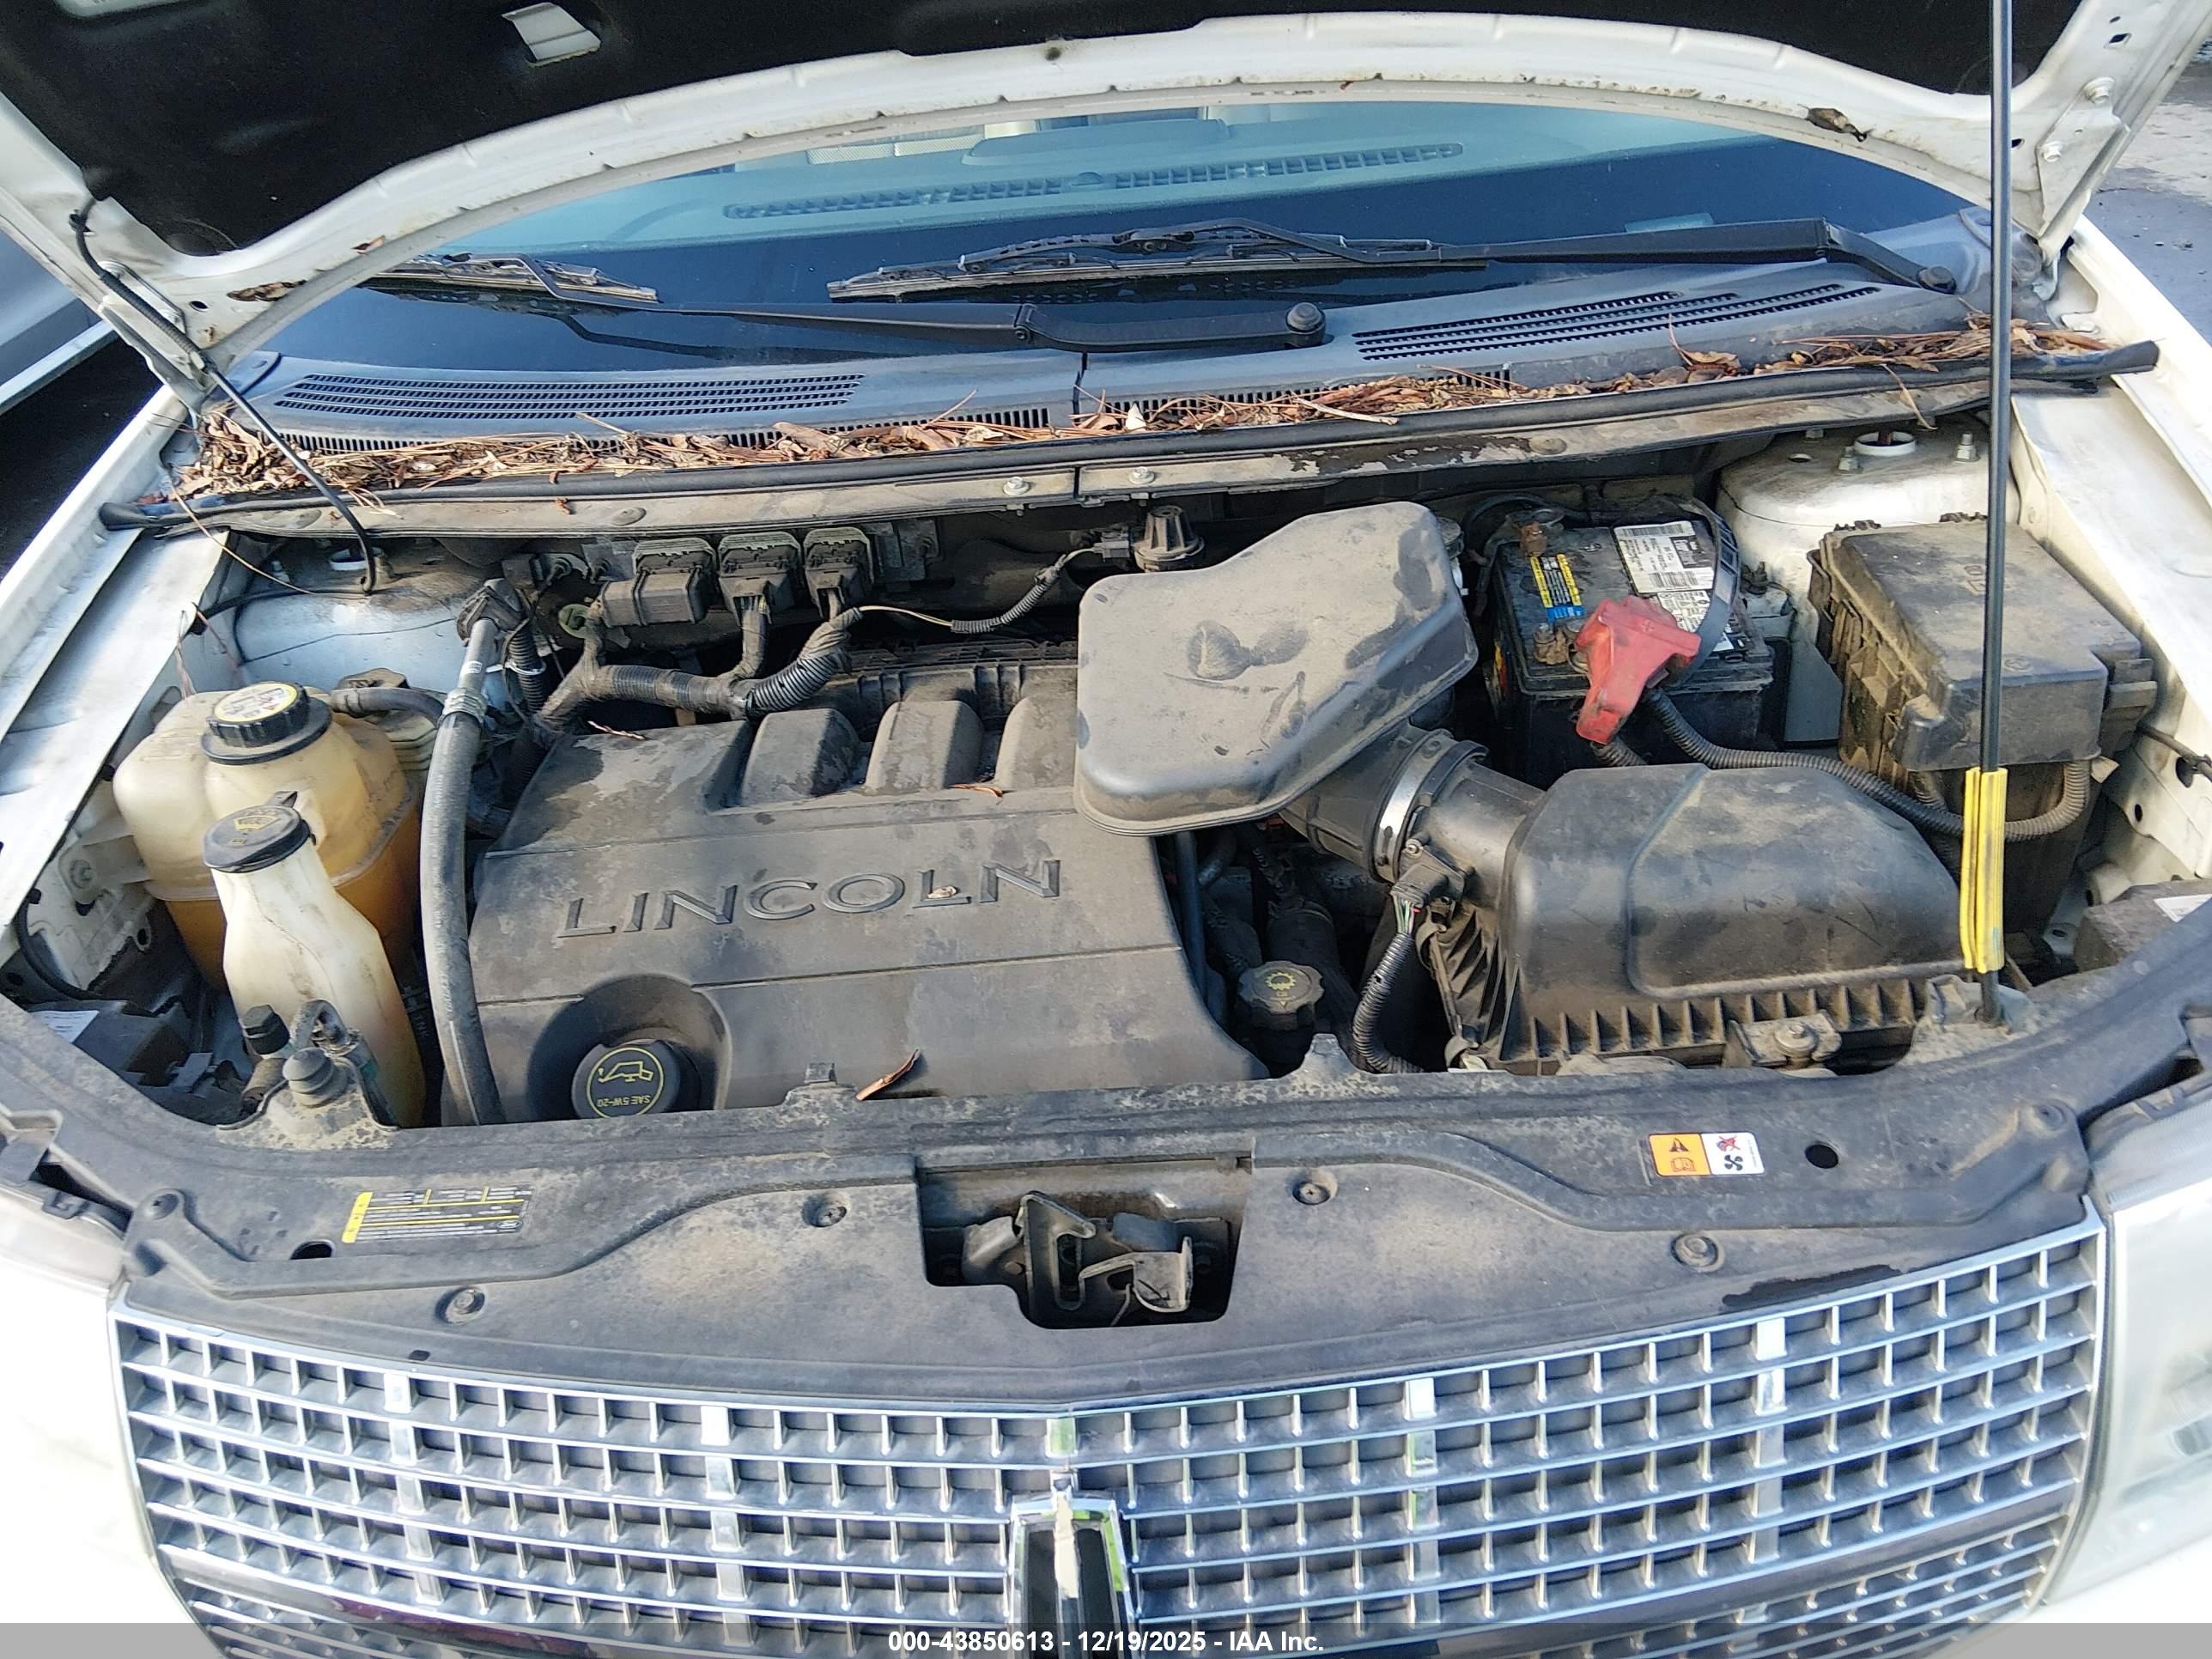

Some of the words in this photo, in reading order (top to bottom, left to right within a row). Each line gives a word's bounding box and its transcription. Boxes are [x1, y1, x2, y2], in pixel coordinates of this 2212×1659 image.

[556, 859, 1060, 938] LINCOLN
[597, 1097, 629, 1108] 5W-20
[630, 1095, 651, 1105] SAE
